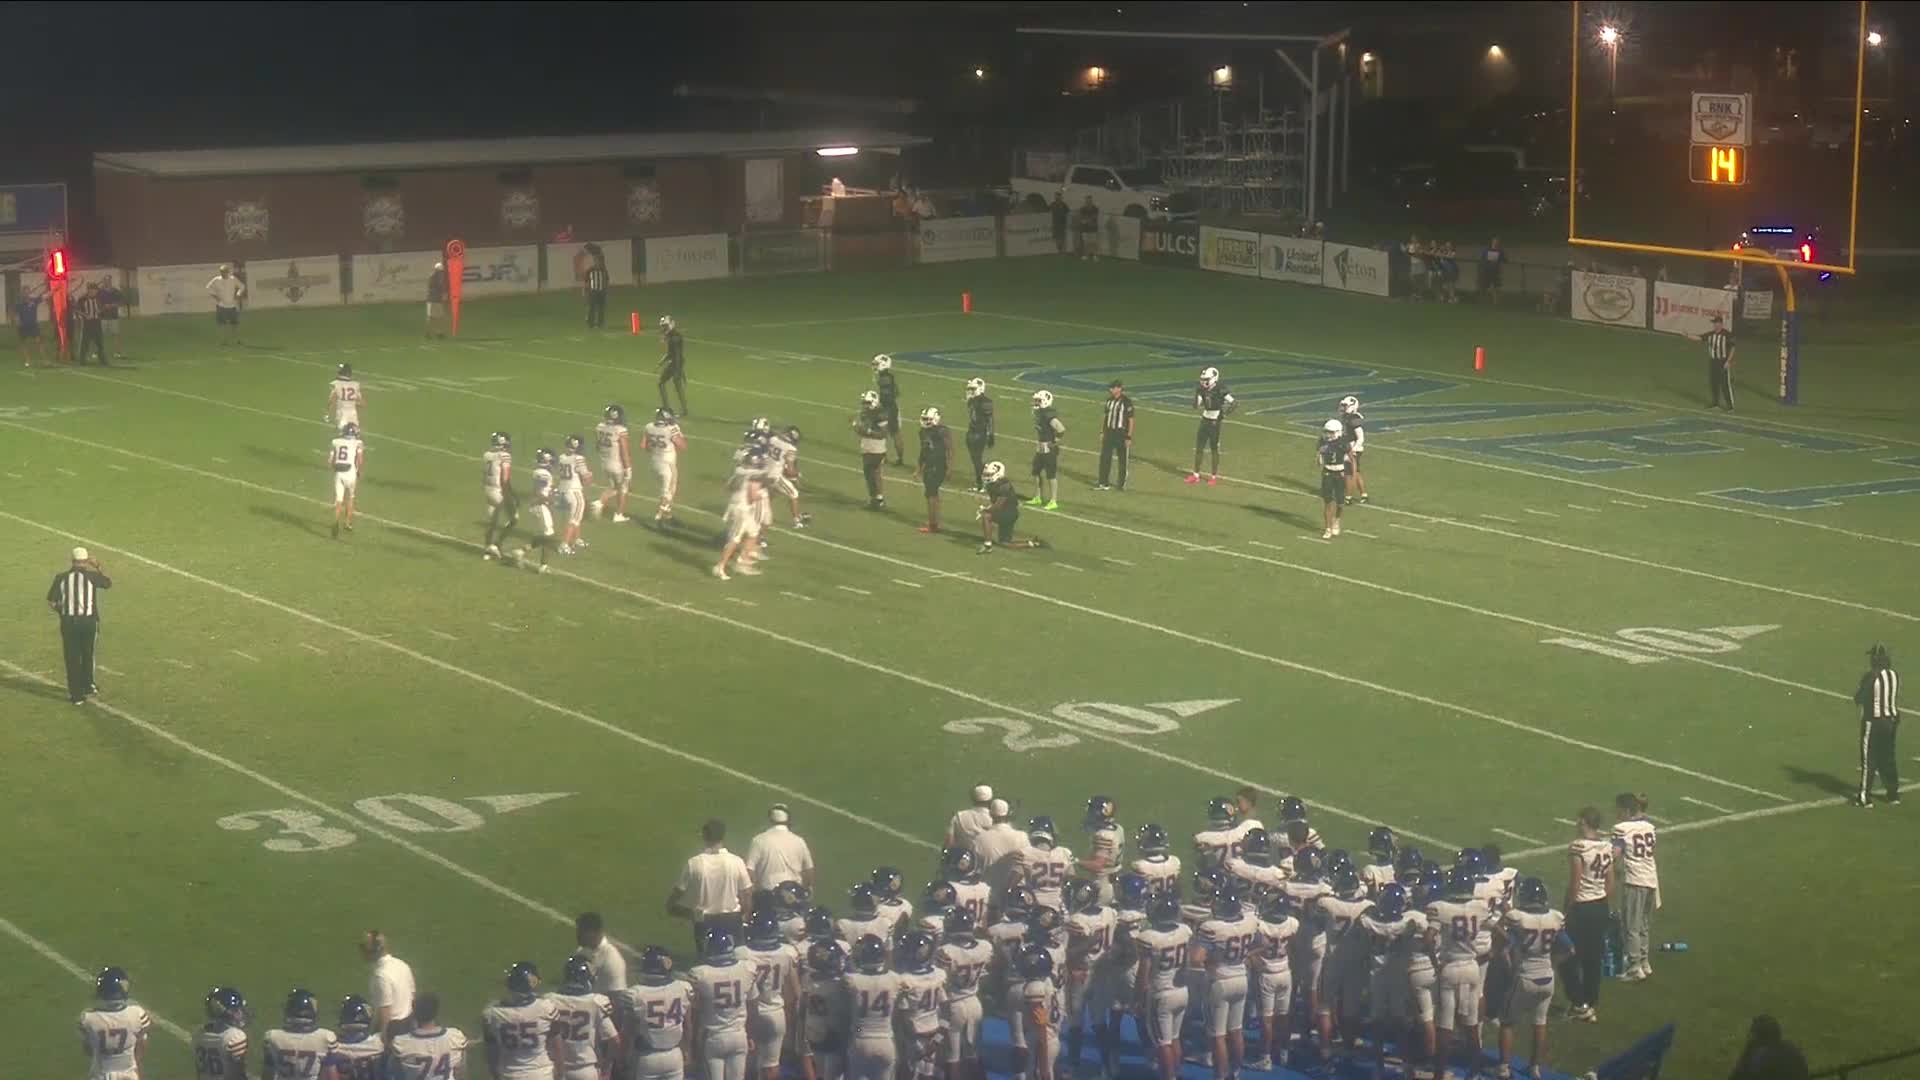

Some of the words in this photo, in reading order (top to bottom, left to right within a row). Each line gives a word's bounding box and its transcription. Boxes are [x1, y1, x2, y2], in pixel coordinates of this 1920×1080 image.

[1711, 146, 1736, 182] 14
[341, 387, 356, 401] 12
[338, 445, 348, 461] 6
[1539, 627, 1742, 664] 10
[943, 701, 1180, 751] 20
[215, 792, 486, 852] 30
[1632, 832, 1656, 858] 69
[1031, 861, 1065, 887] 25
[1590, 853, 1611, 879] 42
[1451, 915, 1478, 942] 81
[1156, 944, 1185, 970] 50
[756, 964, 781, 992] 71
[713, 980, 742, 1009] 51
[855, 990, 892, 1018] 14
[645, 998, 683, 1029] 54
[97, 1028, 128, 1054] 17
